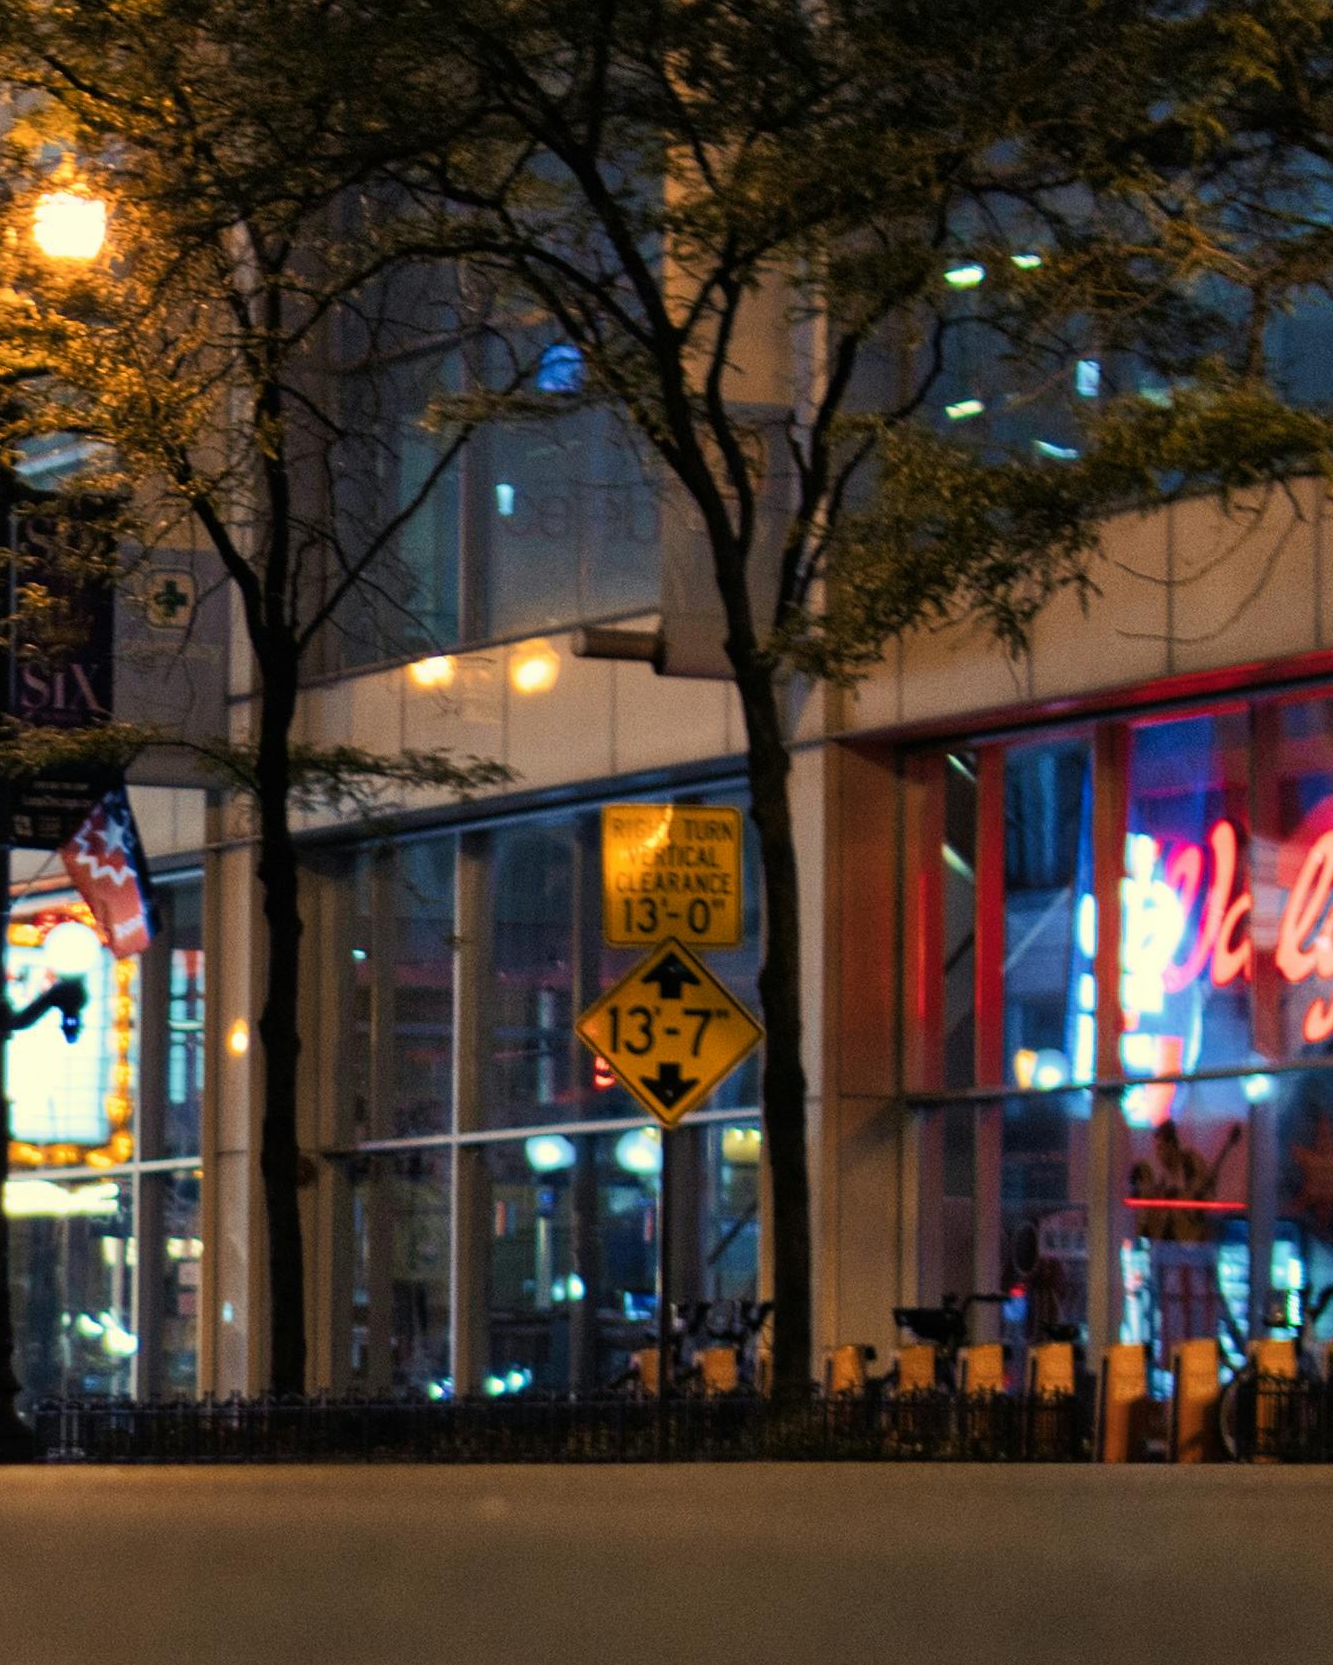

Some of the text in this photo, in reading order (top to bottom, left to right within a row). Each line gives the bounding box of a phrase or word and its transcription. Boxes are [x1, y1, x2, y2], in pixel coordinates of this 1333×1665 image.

[683, 819, 734, 843] TURN
[628, 845, 720, 869] VERTICAL
[615, 872, 732, 896] CLEARANCE
[608, 1005, 731, 1058] 13'-7"
